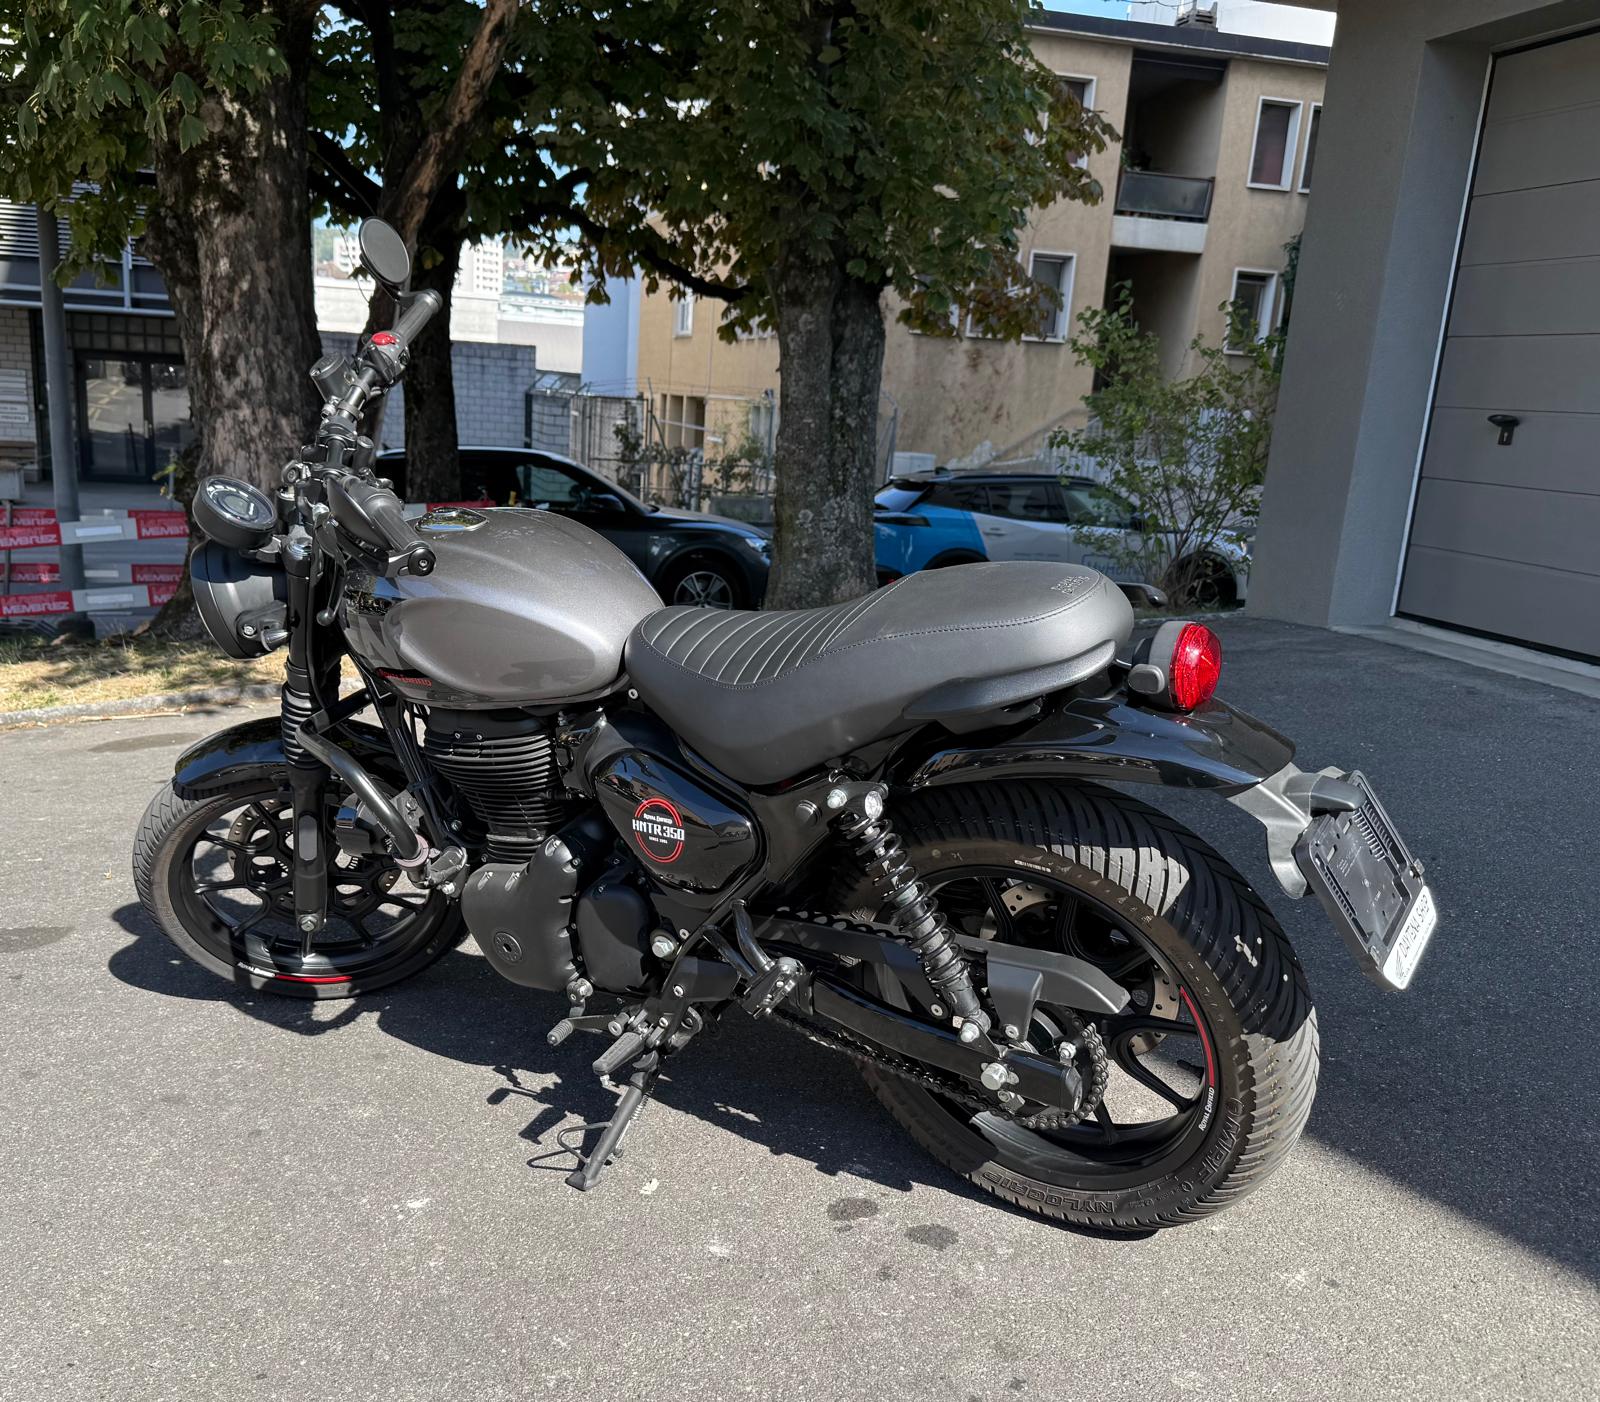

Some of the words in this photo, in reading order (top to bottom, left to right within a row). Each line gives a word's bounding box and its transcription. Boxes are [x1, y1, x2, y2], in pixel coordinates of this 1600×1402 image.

[632, 819, 662, 838] HNTR
[662, 825, 685, 841] 350
[1198, 1112, 1210, 1131] ROYAL
[1205, 1087, 1215, 1113] ENFIELD
